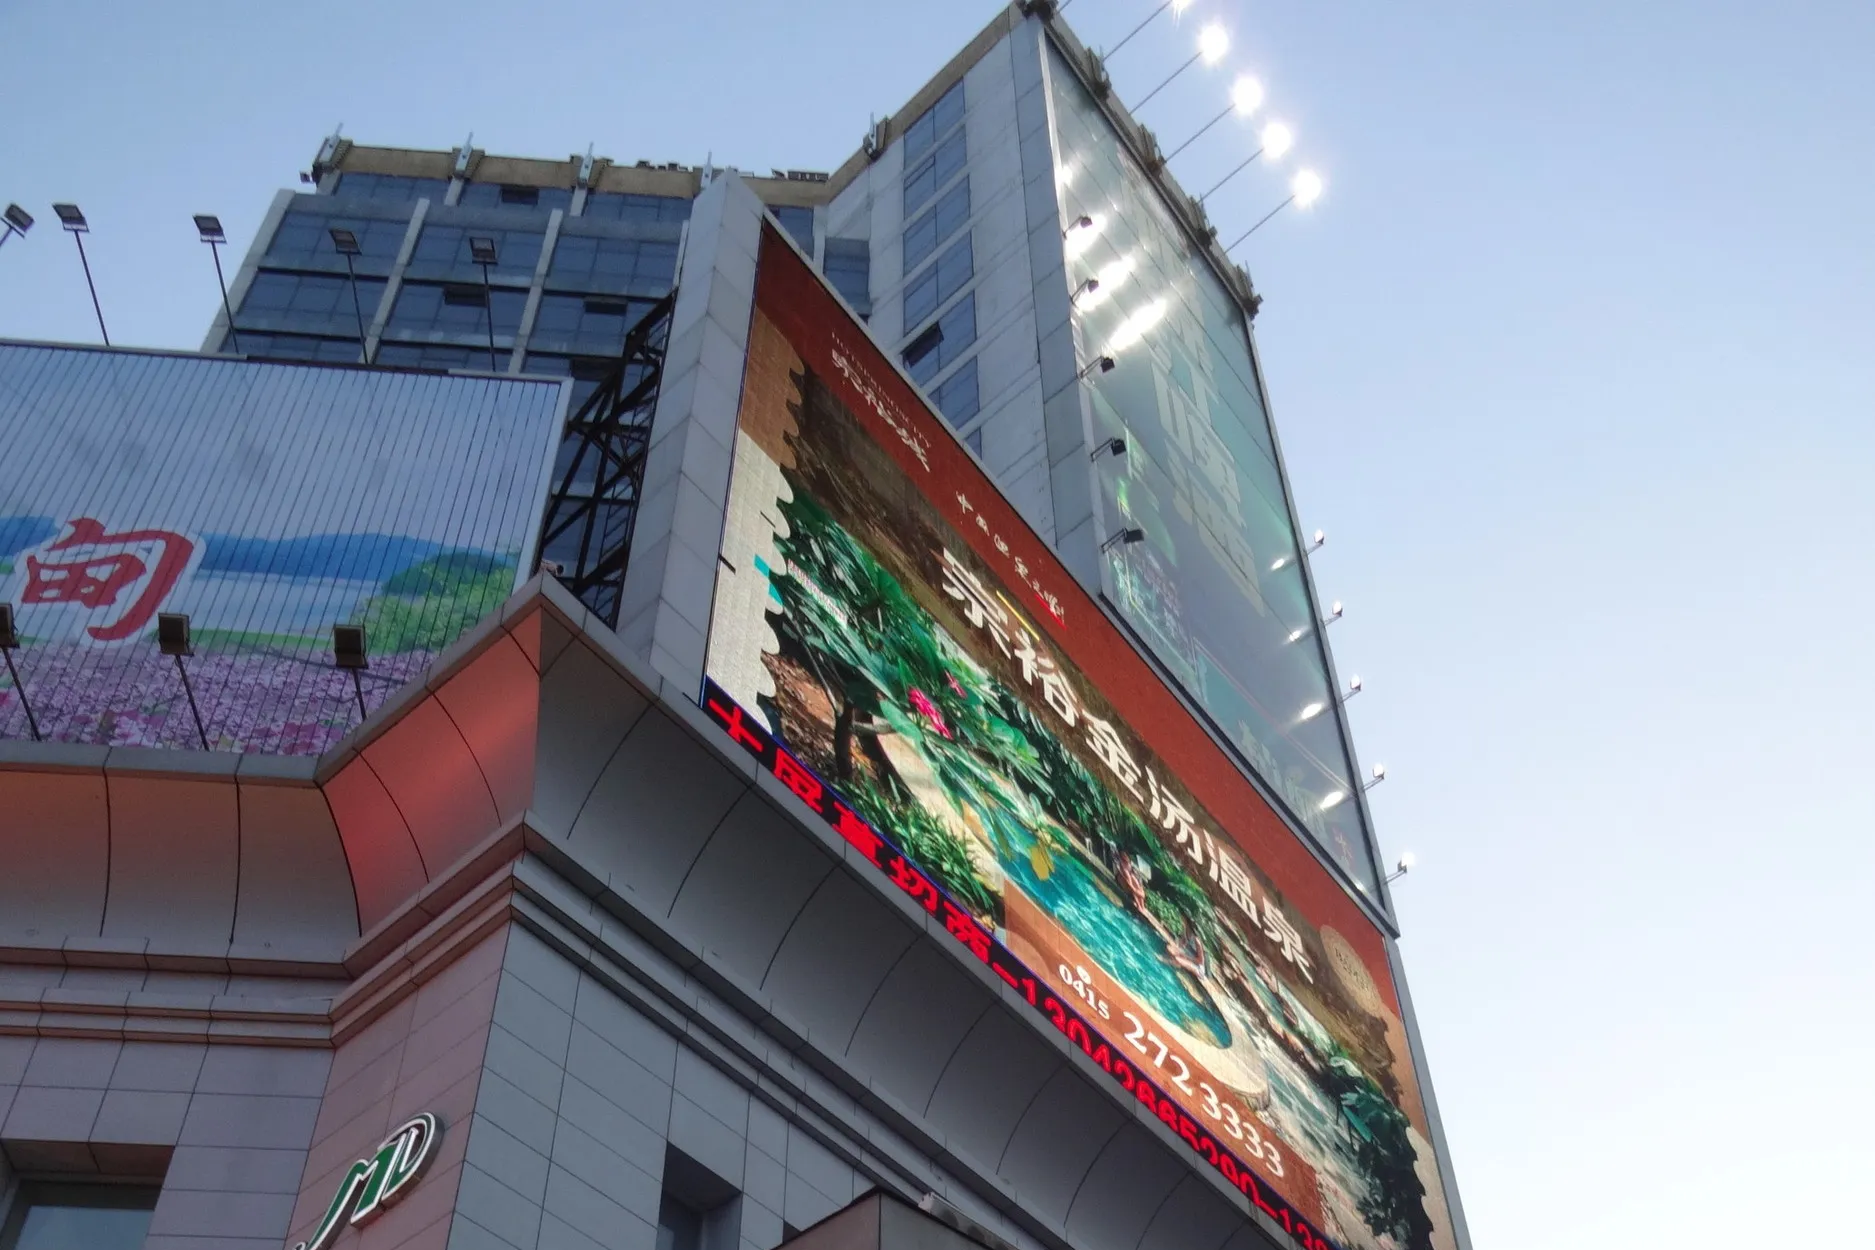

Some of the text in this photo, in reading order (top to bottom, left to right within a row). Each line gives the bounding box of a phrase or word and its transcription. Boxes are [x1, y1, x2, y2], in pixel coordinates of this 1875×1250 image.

[22, 517, 194, 641] 甸
[940, 547, 1315, 985] 宗裕金汤温泉
[1058, 963, 1285, 1178] 0415 2723333
